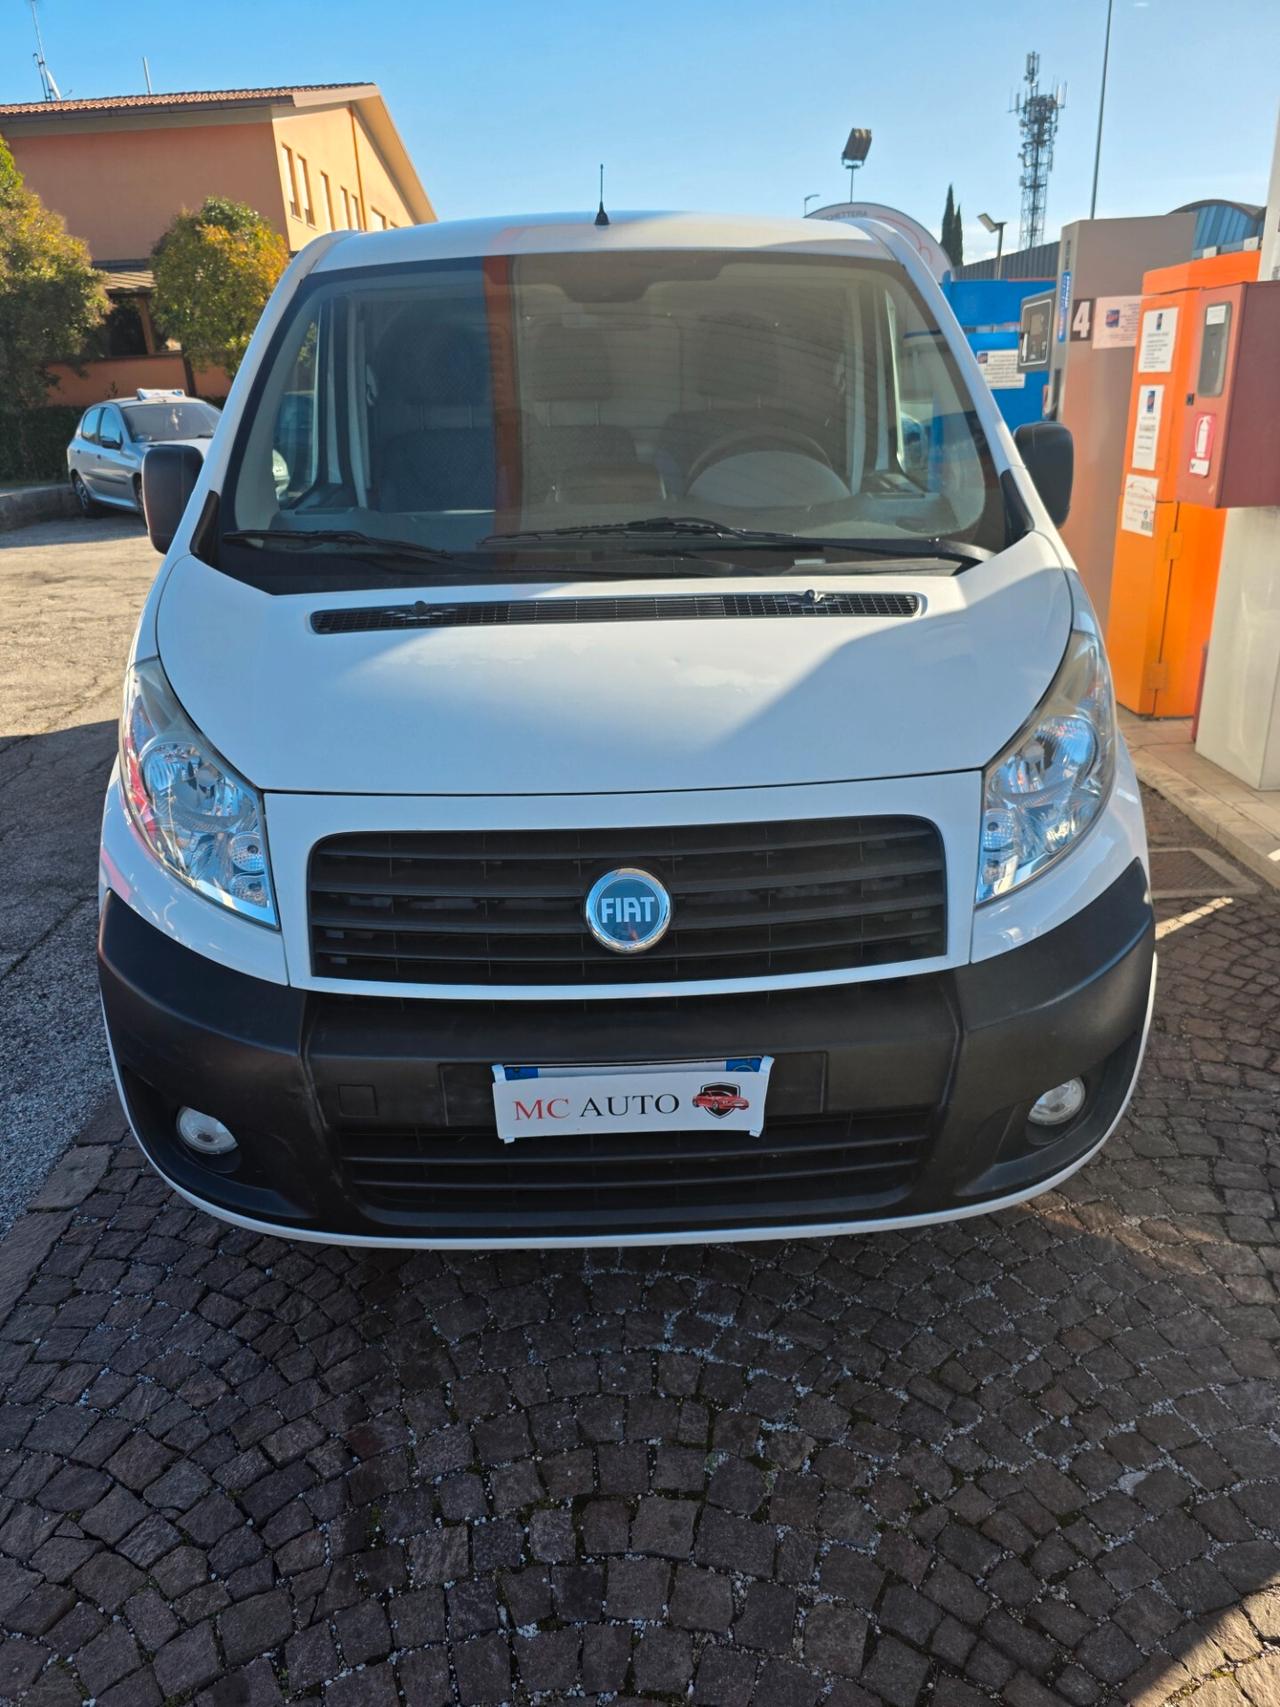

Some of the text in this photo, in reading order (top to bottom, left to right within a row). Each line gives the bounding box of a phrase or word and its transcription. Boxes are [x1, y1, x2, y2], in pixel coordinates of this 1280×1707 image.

[1072, 301, 1090, 338] 4
[601, 897, 655, 923] FIAT
[513, 1094, 679, 1121] MC AUTO
